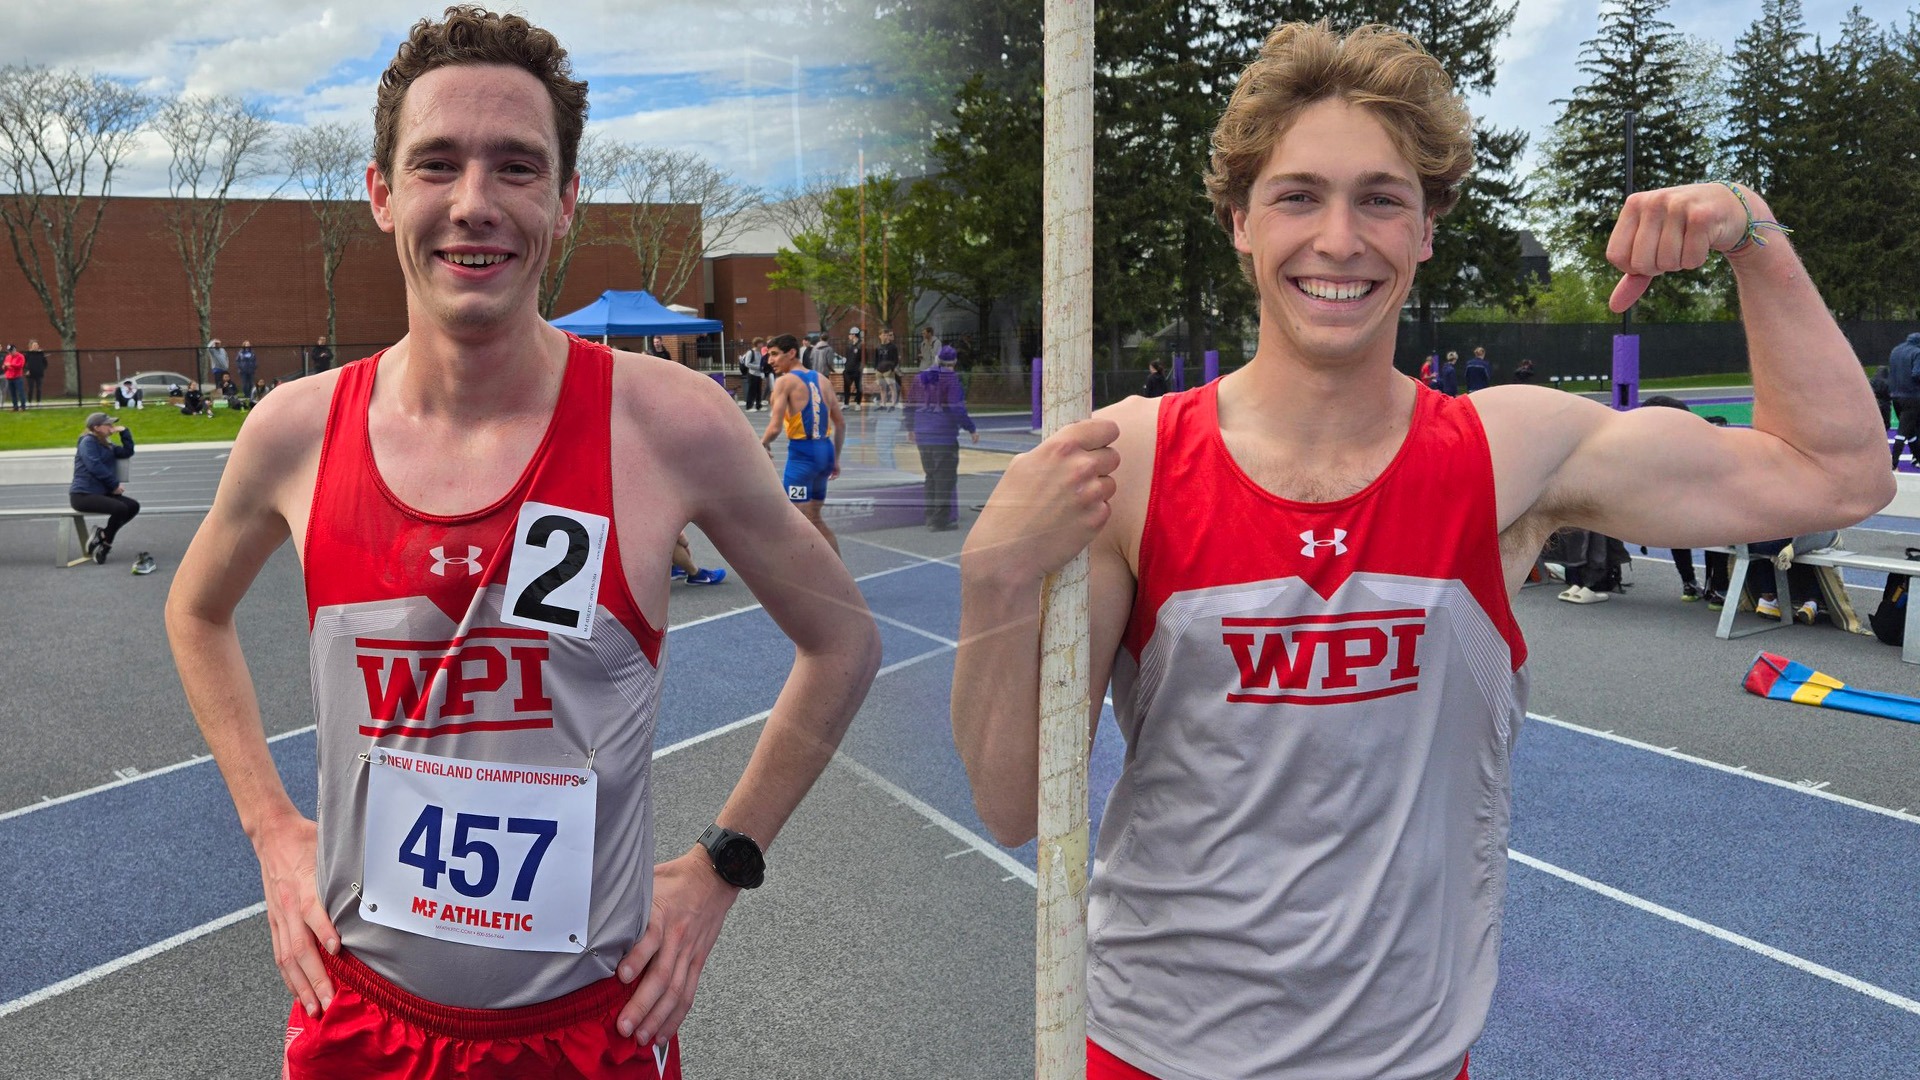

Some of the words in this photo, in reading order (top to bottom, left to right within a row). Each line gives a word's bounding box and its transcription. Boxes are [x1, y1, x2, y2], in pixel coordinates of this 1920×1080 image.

[790, 487, 805, 499] 24
[512, 515, 590, 628] 2
[356, 645, 553, 722] WPI
[1222, 623, 1426, 690] WPI
[387, 754, 413, 773] NEW
[415, 760, 473, 780] ENGLAND
[476, 767, 580, 787] CHAMPIONSHIPS
[398, 804, 559, 902] 457
[440, 904, 533, 932] ATHLETIC
